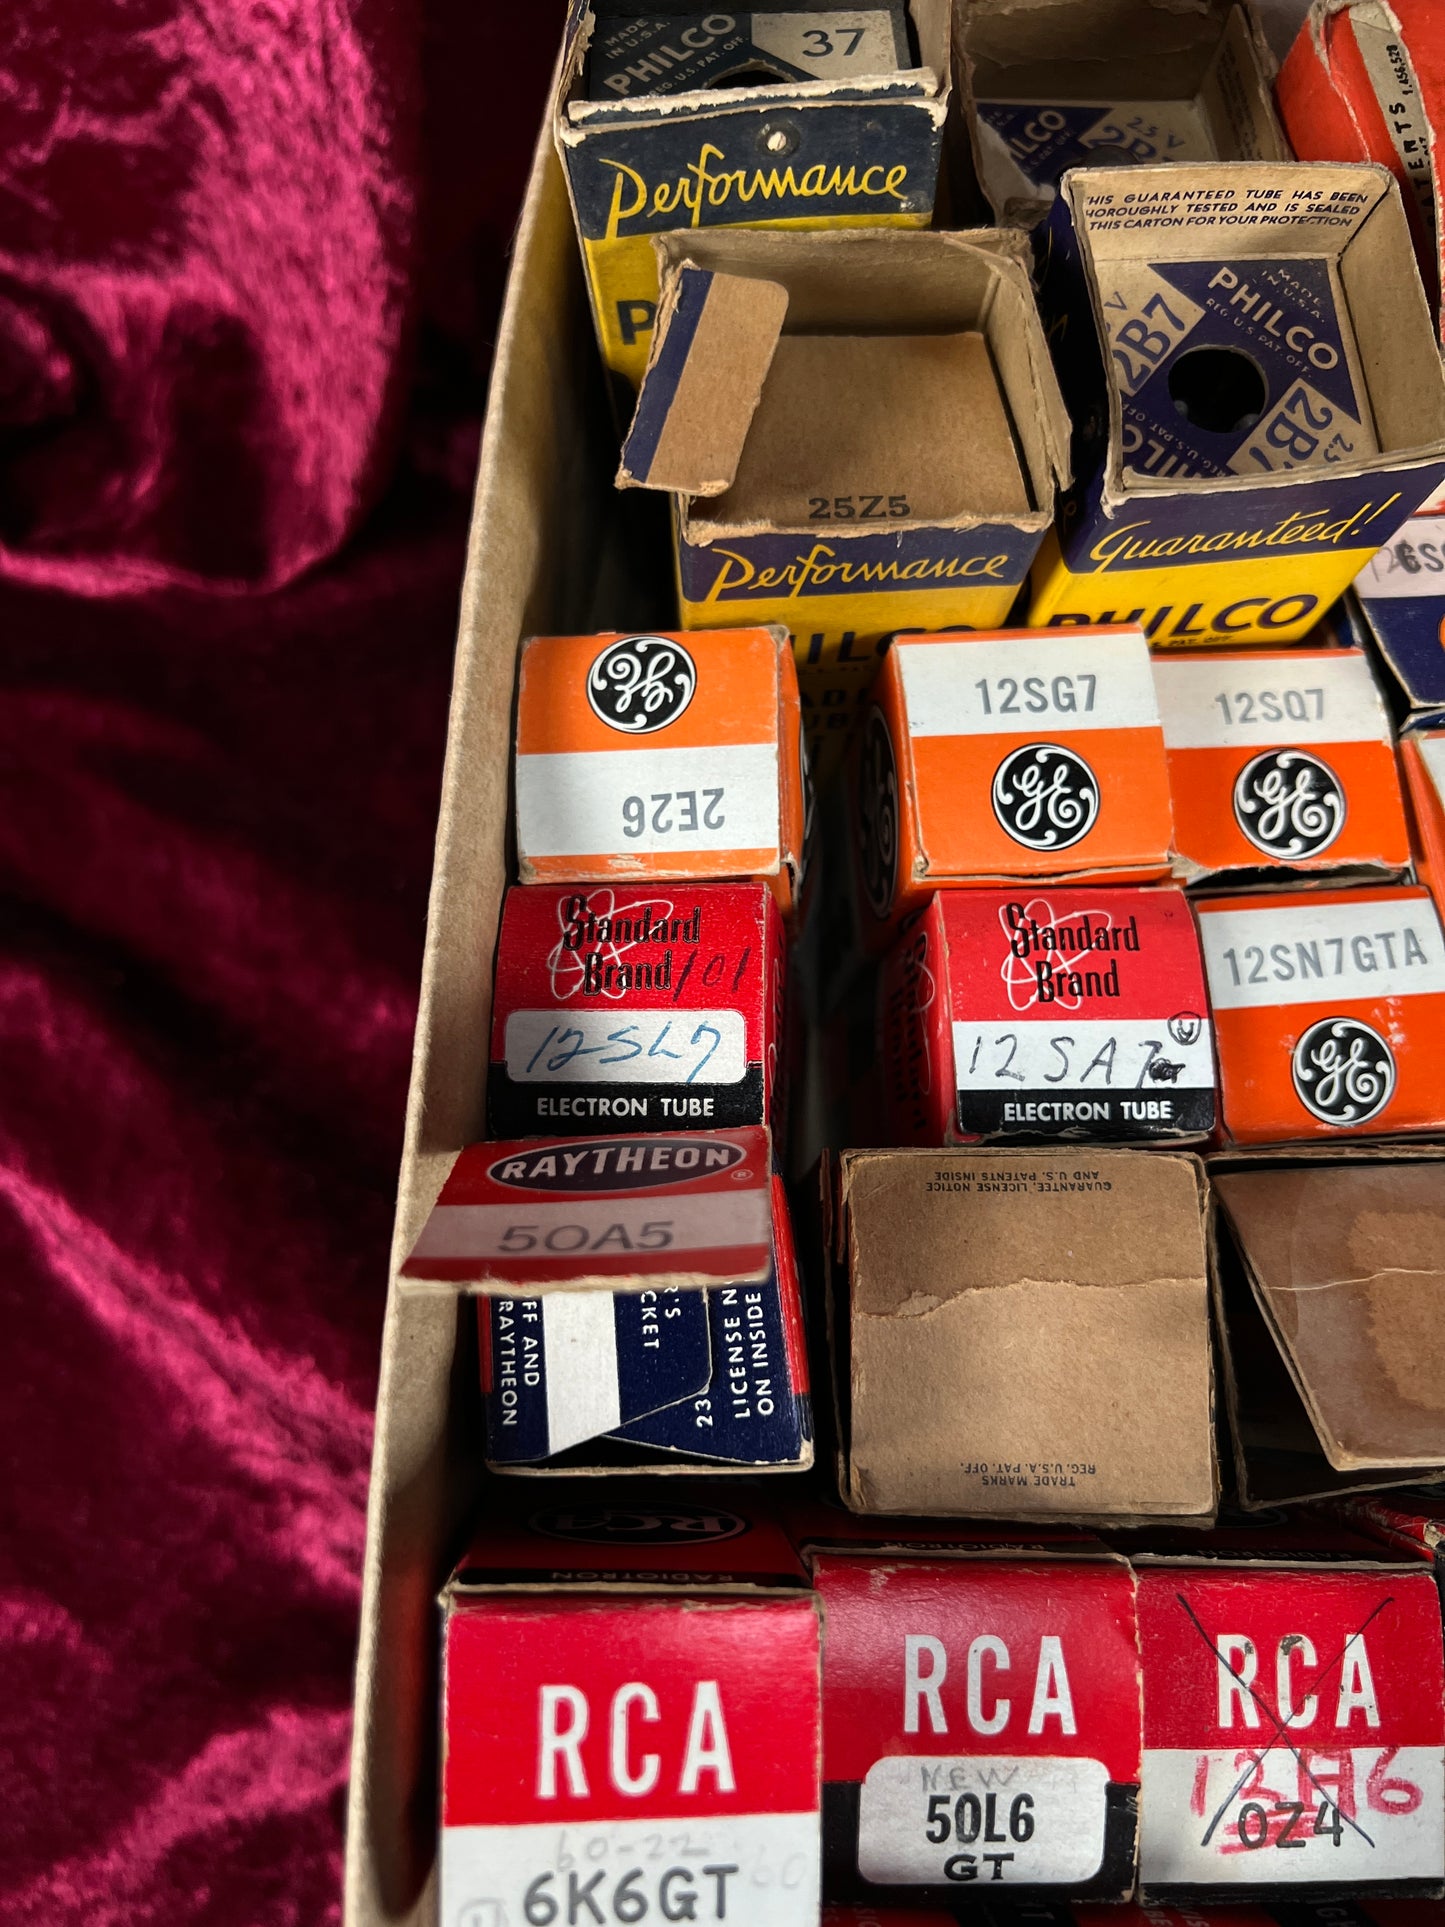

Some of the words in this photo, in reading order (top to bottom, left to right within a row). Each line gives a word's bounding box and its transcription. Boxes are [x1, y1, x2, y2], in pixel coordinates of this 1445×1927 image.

[604, 18, 649, 47] MADE
[605, 47, 625, 59] IN
[625, 21, 671, 47] U.S.A.
[723, 36, 749, 50] OFF.
[802, 28, 866, 57] 37
[603, 14, 736, 95] PHILCO
[600, 143, 909, 239] Performance
[1087, 195, 1113, 206] HIS
[1124, 190, 1236, 204] GUARANTEED
[1246, 189, 1284, 200] TUBE
[1291, 190, 1323, 200] HAS
[1330, 191, 1368, 203] BEEN
[1085, 205, 1178, 218] HOROUGHLY
[1186, 203, 1238, 213] TESTED
[1245, 202, 1277, 212] AND
[1284, 203, 1299, 212] IS
[1305, 203, 1361, 215] SEALED
[1089, 220, 1120, 231] THIS
[1124, 217, 1183, 229] CARTON
[1186, 216, 1216, 226] FOR
[1218, 215, 1258, 225] YOUR
[1259, 215, 1353, 227] PROTECTION
[1207, 266, 1338, 370] PHILCO
[1111, 292, 1185, 391] 2B7
[808, 495, 912, 520] 25Z5
[1089, 491, 1403, 574] Guaranteed!
[706, 544, 1009, 602] Performance
[974, 674, 1098, 716] 12SG7
[1214, 688, 1325, 726] 12SQ7
[622, 788, 726, 838] 2E26
[564, 894, 701, 951] Standard
[1006, 903, 1140, 958] Standard
[583, 949, 673, 996] Brand
[1222, 927, 1430, 987] 12SN7GTA
[1036, 958, 1120, 1003] Brand
[537, 1097, 648, 1117] ELECTRON
[660, 1097, 715, 1117] TUBE
[1003, 1102, 1110, 1122] ELECTRON
[1120, 1100, 1174, 1120] TUBE
[501, 1146, 729, 1180] RAYTHEON
[934, 1171, 976, 1181] INSIDE
[981, 1172, 1037, 1181] PATENTS
[1042, 1171, 1068, 1180] U.S.
[1073, 1171, 1100, 1180] AND
[926, 1182, 970, 1192] NOTICE
[977, 1183, 1028, 1192] LICENSE
[1033, 1182, 1112, 1192] GUARANTEE,
[745, 1292, 769, 1368] INSIDE
[499, 1300, 518, 1426] RAYTHEON
[523, 1336, 540, 1386] AND
[724, 1316, 751, 1419] LICENSE
[755, 1378, 775, 1417] ON
[960, 1463, 988, 1474] OFF.
[982, 1475, 1028, 1487] MARKS
[992, 1463, 1021, 1474] PAT.
[1025, 1463, 1063, 1474] U.S.A.
[1033, 1475, 1076, 1487] TRADE
[1066, 1463, 1096, 1475] REG.
[552, 1570, 734, 1582] RADIOTRON
[903, 1633, 1078, 1736] RCA
[1217, 1633, 1381, 1729] RCA
[537, 1680, 737, 1799] RCA
[920, 1765, 1020, 1792] NEW
[926, 1792, 1035, 1844] 50L6
[944, 1852, 1015, 1881] GT
[522, 1862, 740, 1927] 6K6GT
